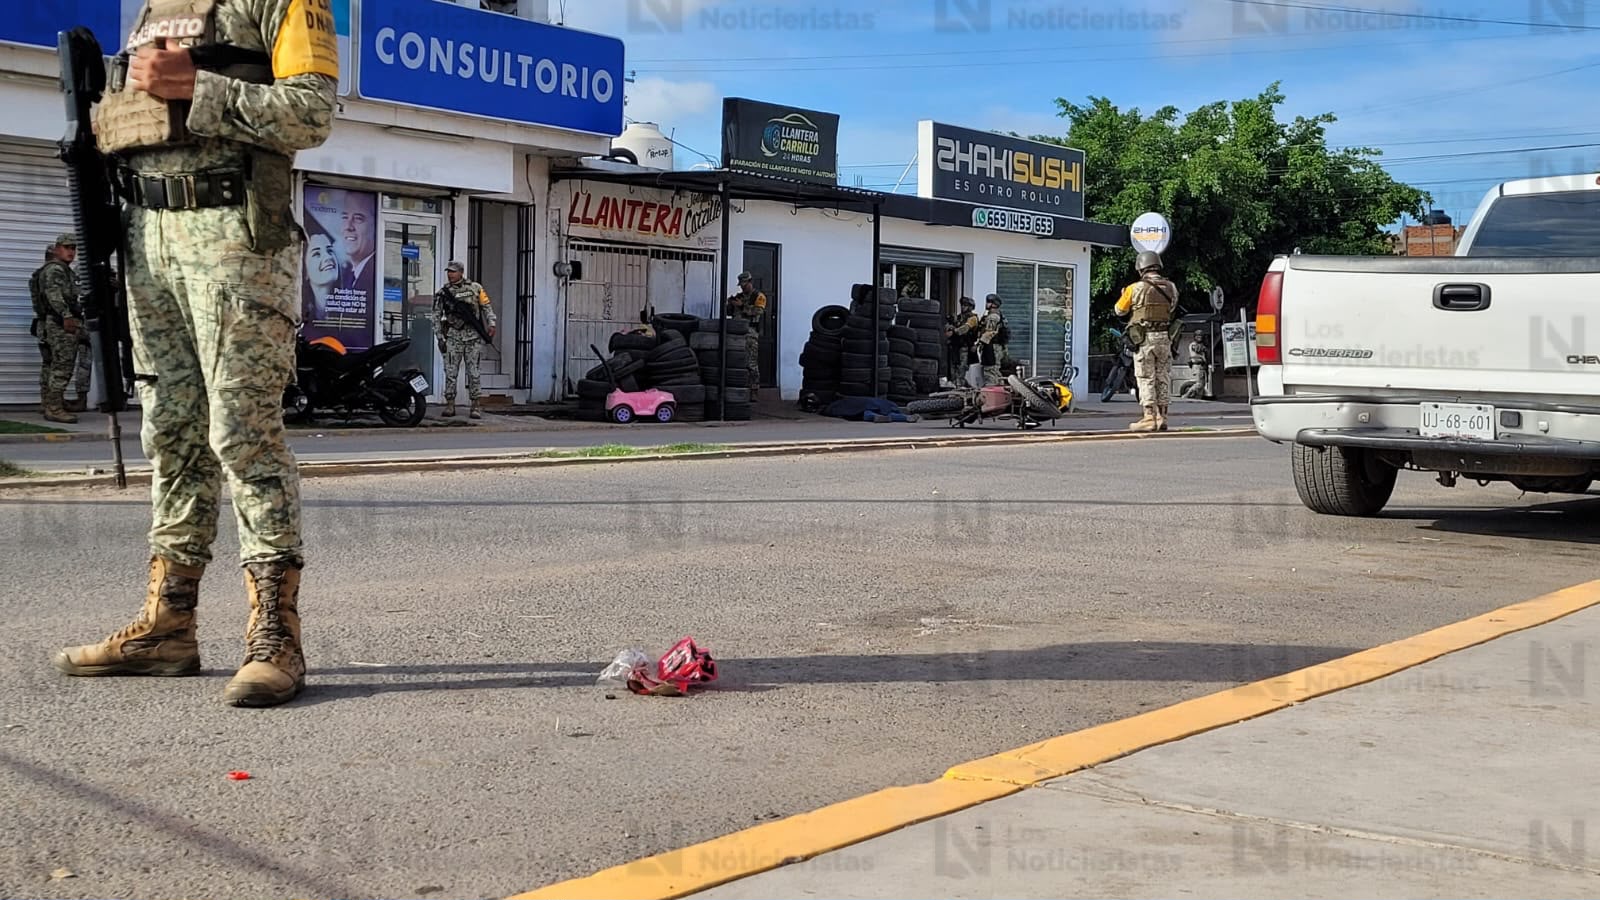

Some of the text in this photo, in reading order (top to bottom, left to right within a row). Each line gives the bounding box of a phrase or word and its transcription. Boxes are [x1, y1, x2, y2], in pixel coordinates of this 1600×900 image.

[375, 27, 614, 104] CONSULTORIO
[781, 126, 819, 143] LLANTERA
[780, 139, 819, 156] CARRILLO
[791, 154, 811, 163] HORAS
[769, 164, 790, 173] LLANTAS
[954, 179, 1060, 205] ES OTRO ROLLO
[568, 191, 683, 236] LLANTERA
[987, 211, 1053, 234] 669 1453 653
[1302, 348, 1373, 359] SILVERADO
[1422, 411, 1490, 431] UJ-68-601
